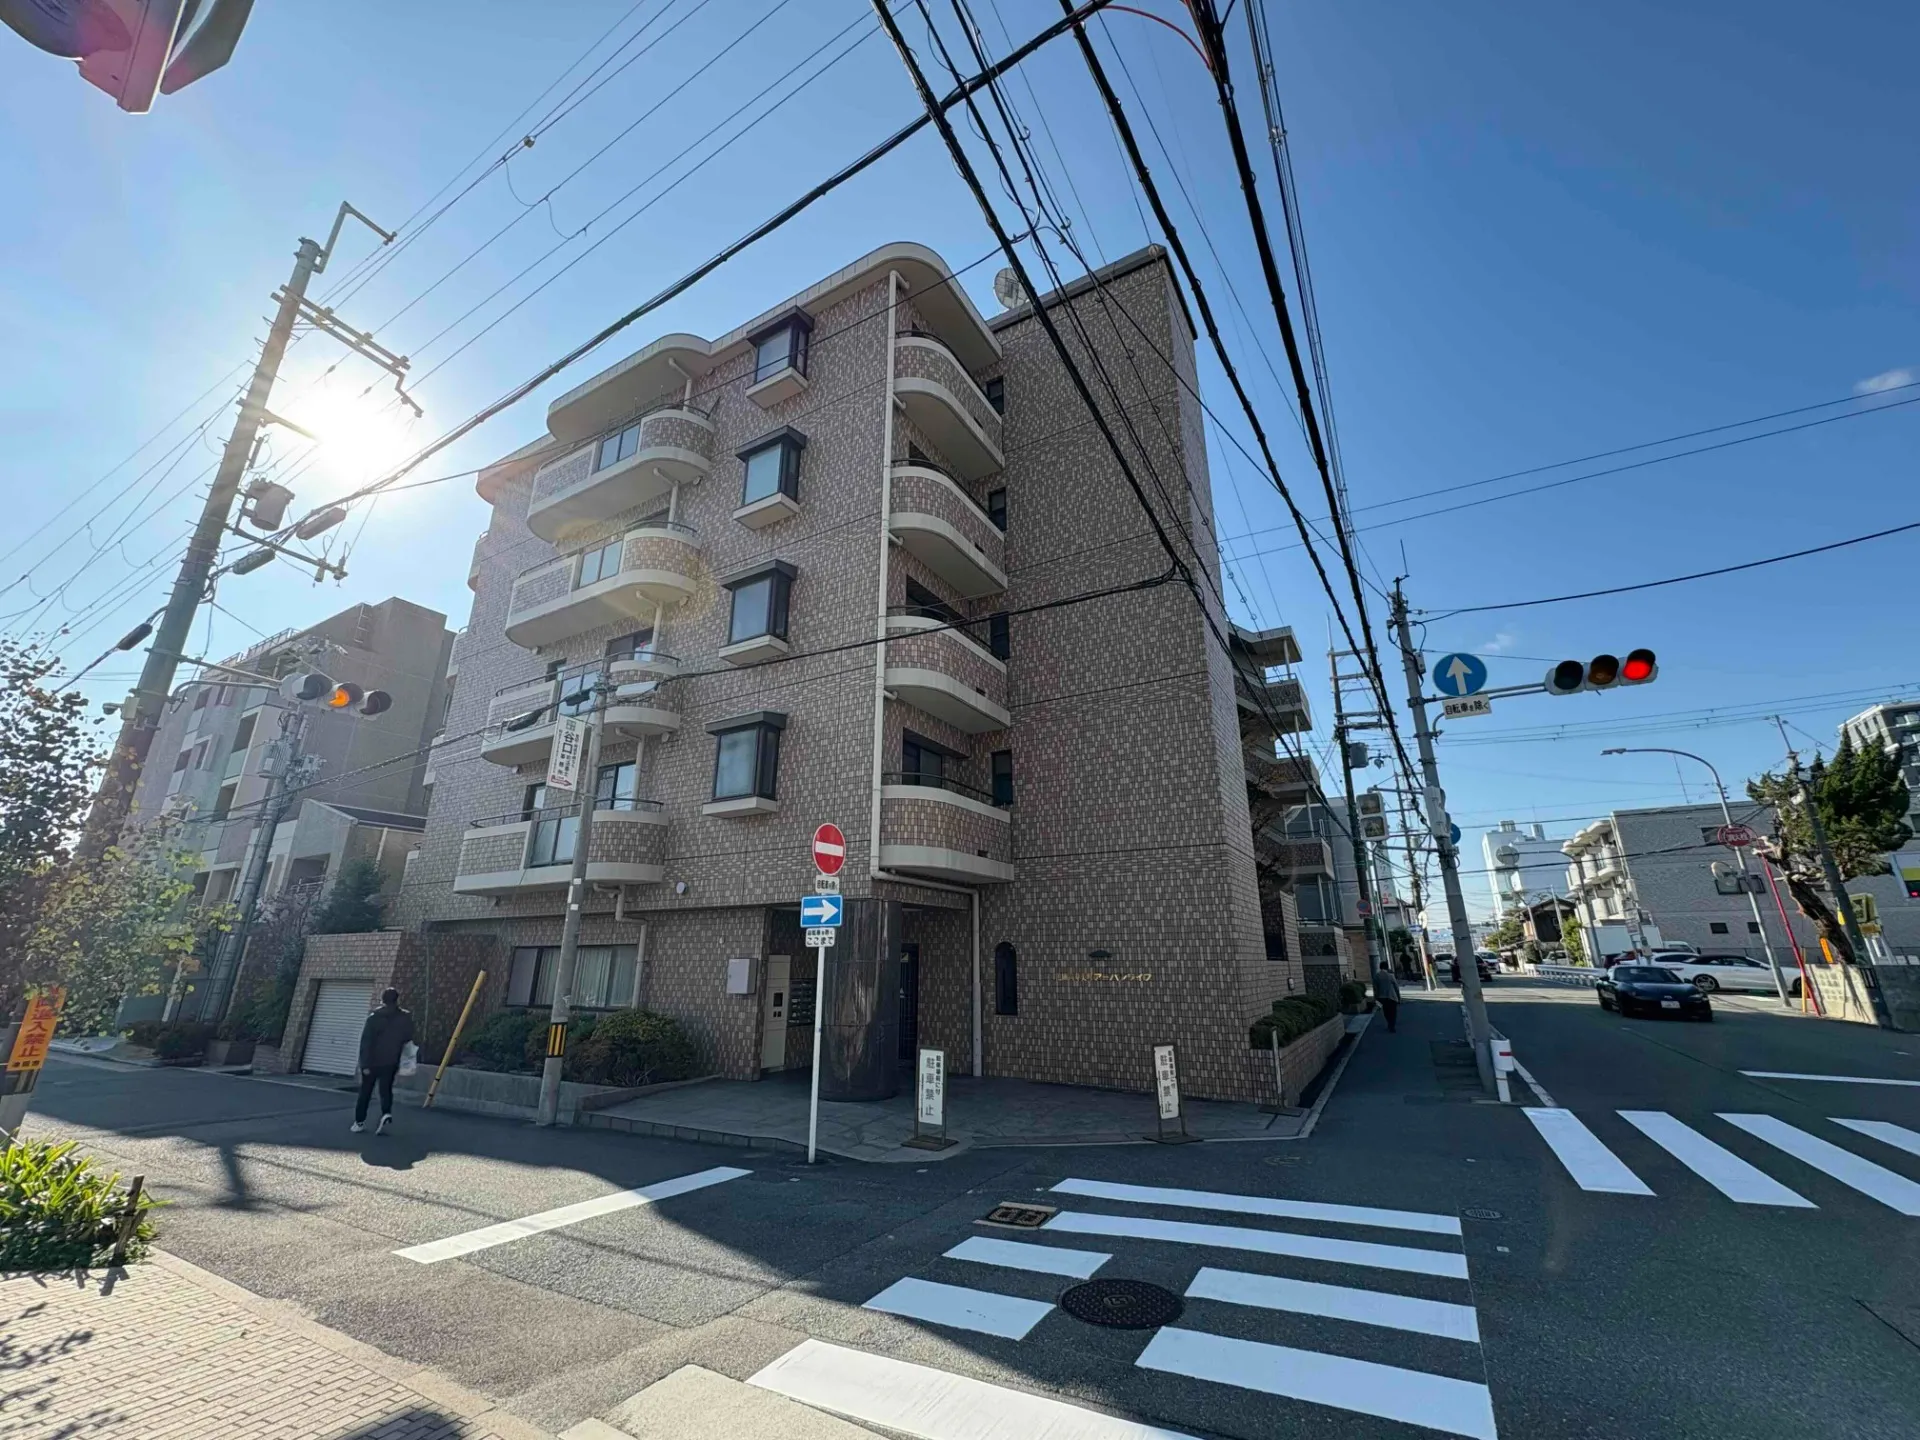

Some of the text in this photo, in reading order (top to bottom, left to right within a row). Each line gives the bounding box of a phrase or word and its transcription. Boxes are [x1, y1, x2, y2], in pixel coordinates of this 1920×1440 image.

[1445, 700, 1489, 715] 自転車を除く
[562, 731, 575, 754] 谷口
[807, 936, 833, 945] ここまで
[925, 1056, 935, 1116] 駐車禁止
[1160, 1054, 1172, 1113] 駐車禁止
